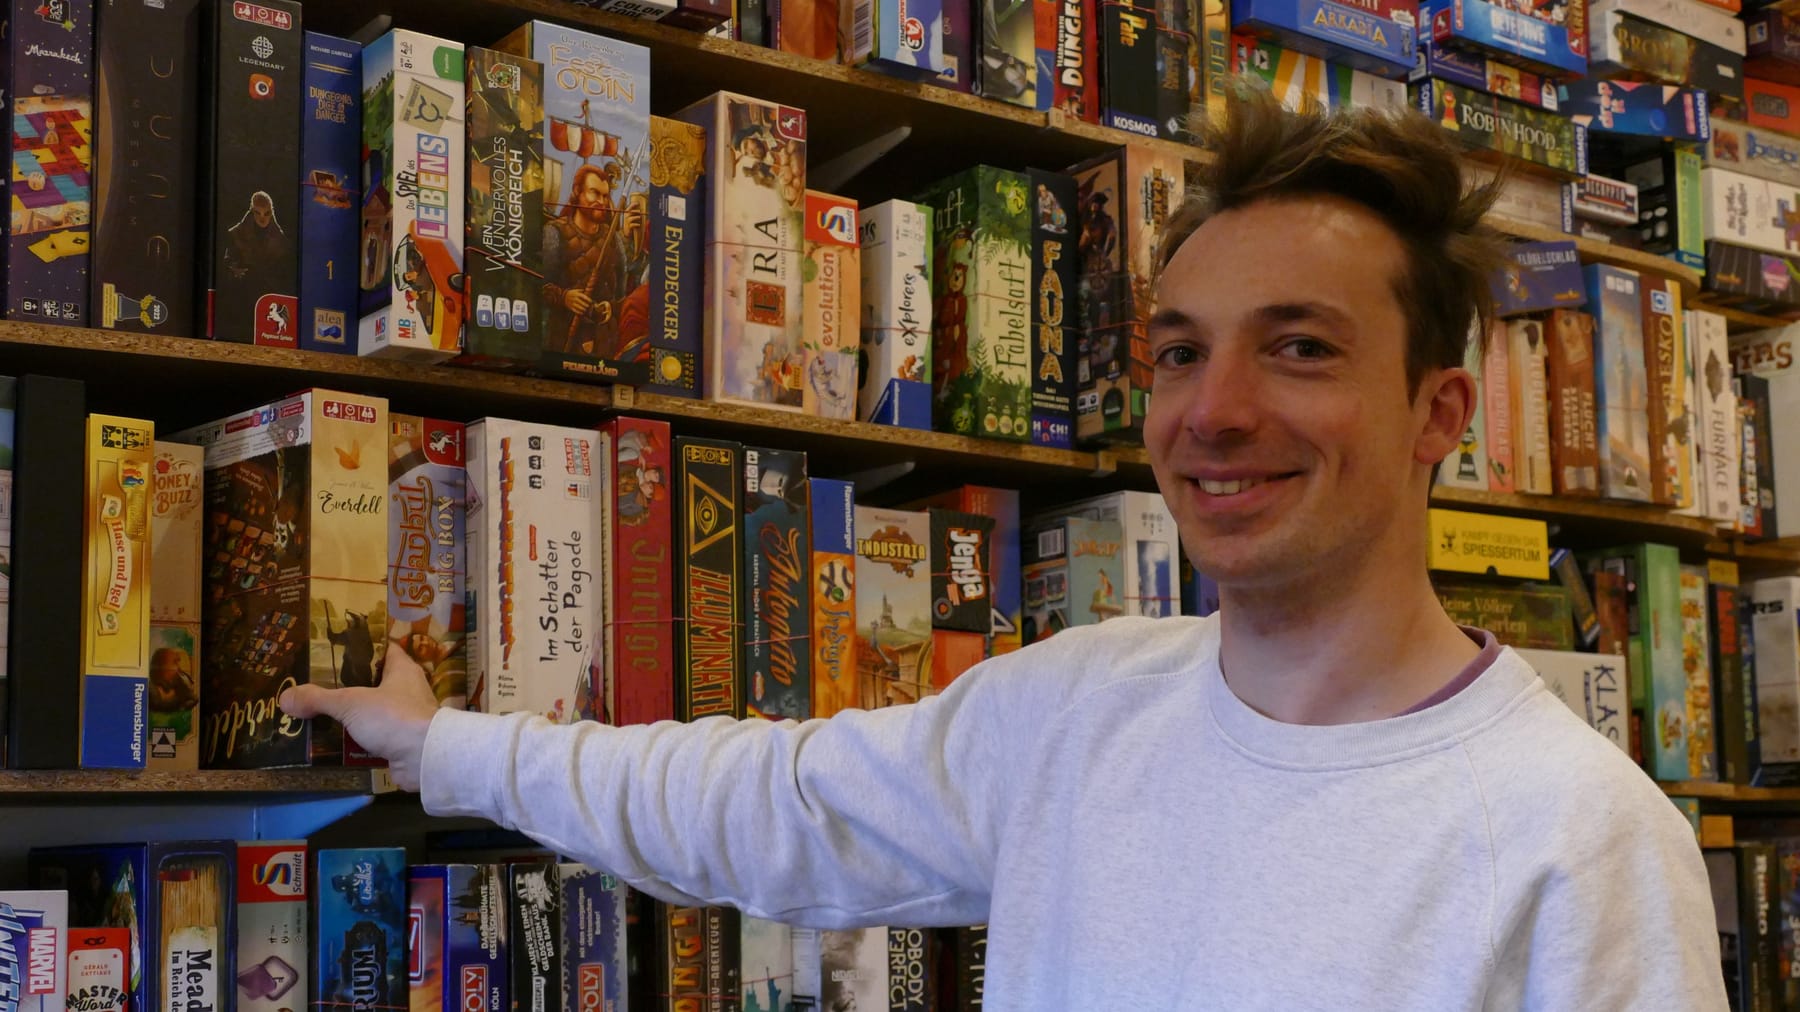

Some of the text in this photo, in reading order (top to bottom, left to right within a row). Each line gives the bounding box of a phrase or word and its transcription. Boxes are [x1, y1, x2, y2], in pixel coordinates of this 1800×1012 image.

[613, 1, 664, 16] COLOR
[1313, 8, 1388, 48] ARKADIA
[239, 56, 286, 72] LEGENDARY
[1062, 0, 1084, 87] DUNGE
[1211, 39, 1226, 96] DUEL
[318, 99, 336, 112] DICE
[556, 67, 636, 104] ODIN
[315, 109, 346, 124] DANGER
[1114, 115, 1158, 137] KOSMOS
[1461, 103, 1512, 138] ROBIN
[1513, 122, 1557, 151] HOOD
[1575, 125, 1586, 175] KOSMOS
[395, 159, 419, 210] Das SPIEL des
[417, 134, 449, 239] LEBENS
[485, 136, 507, 272] WUNDERVOLLES
[507, 149, 523, 266] KÖNIGREICH
[483, 225, 493, 245] EIN
[1516, 250, 1577, 266] FLÜGELSCHLAG
[326, 259, 334, 281] 1
[664, 225, 684, 341] ENTDECKER
[317, 312, 342, 326] alea
[819, 252, 834, 347] evolution
[897, 272, 920, 348] eXplorers
[993, 258, 1026, 368] Fabelsaft
[1039, 240, 1065, 383] FAUNA
[374, 316, 386, 336] MB
[398, 318, 411, 339] MB
[562, 361, 619, 377] FEUERLAND
[1582, 391, 1596, 450] FLUCHT
[564, 437, 575, 475] BOARD
[580, 439, 591, 477] CIRCUS
[1712, 409, 1730, 489] FURNACE
[157, 489, 193, 514] BUZZ
[317, 489, 383, 515] Everdell
[843, 484, 855, 550] Ravensburger
[107, 520, 128, 609] Hase und Igel
[393, 476, 435, 610] Istanbul
[438, 496, 455, 594] BIG BOX
[856, 538, 927, 560] INDUSTRIA
[949, 529, 985, 600] Jenga
[1462, 542, 1541, 562] SPIESSERTUM
[539, 539, 559, 662] Im Schatten
[562, 530, 593, 653] der Pagode
[625, 537, 665, 673] Intrige
[690, 564, 734, 717] ILLUMINATI
[819, 604, 850, 681] Indigo
[130, 682, 146, 763] Ravensburger
[292, 853, 303, 893] Schmidt
[480, 884, 489, 949] DAS BERÜHMTE
[489, 874, 498, 960] GESELLSCHAFTSSPIEL
[531, 903, 540, 921] AUS
[541, 915, 555, 957] DER BANK
[29, 929, 55, 993] MARVEL
[171, 951, 183, 965] Im
[519, 904, 539, 976] KLAUEN SIE EINEN
[534, 921, 550, 971] GELDSCHEIN
[67, 984, 128, 1010] MASTER
[75, 996, 116, 1011] Word
[171, 968, 183, 998] Reich
[490, 986, 500, 1011] KÖLN
